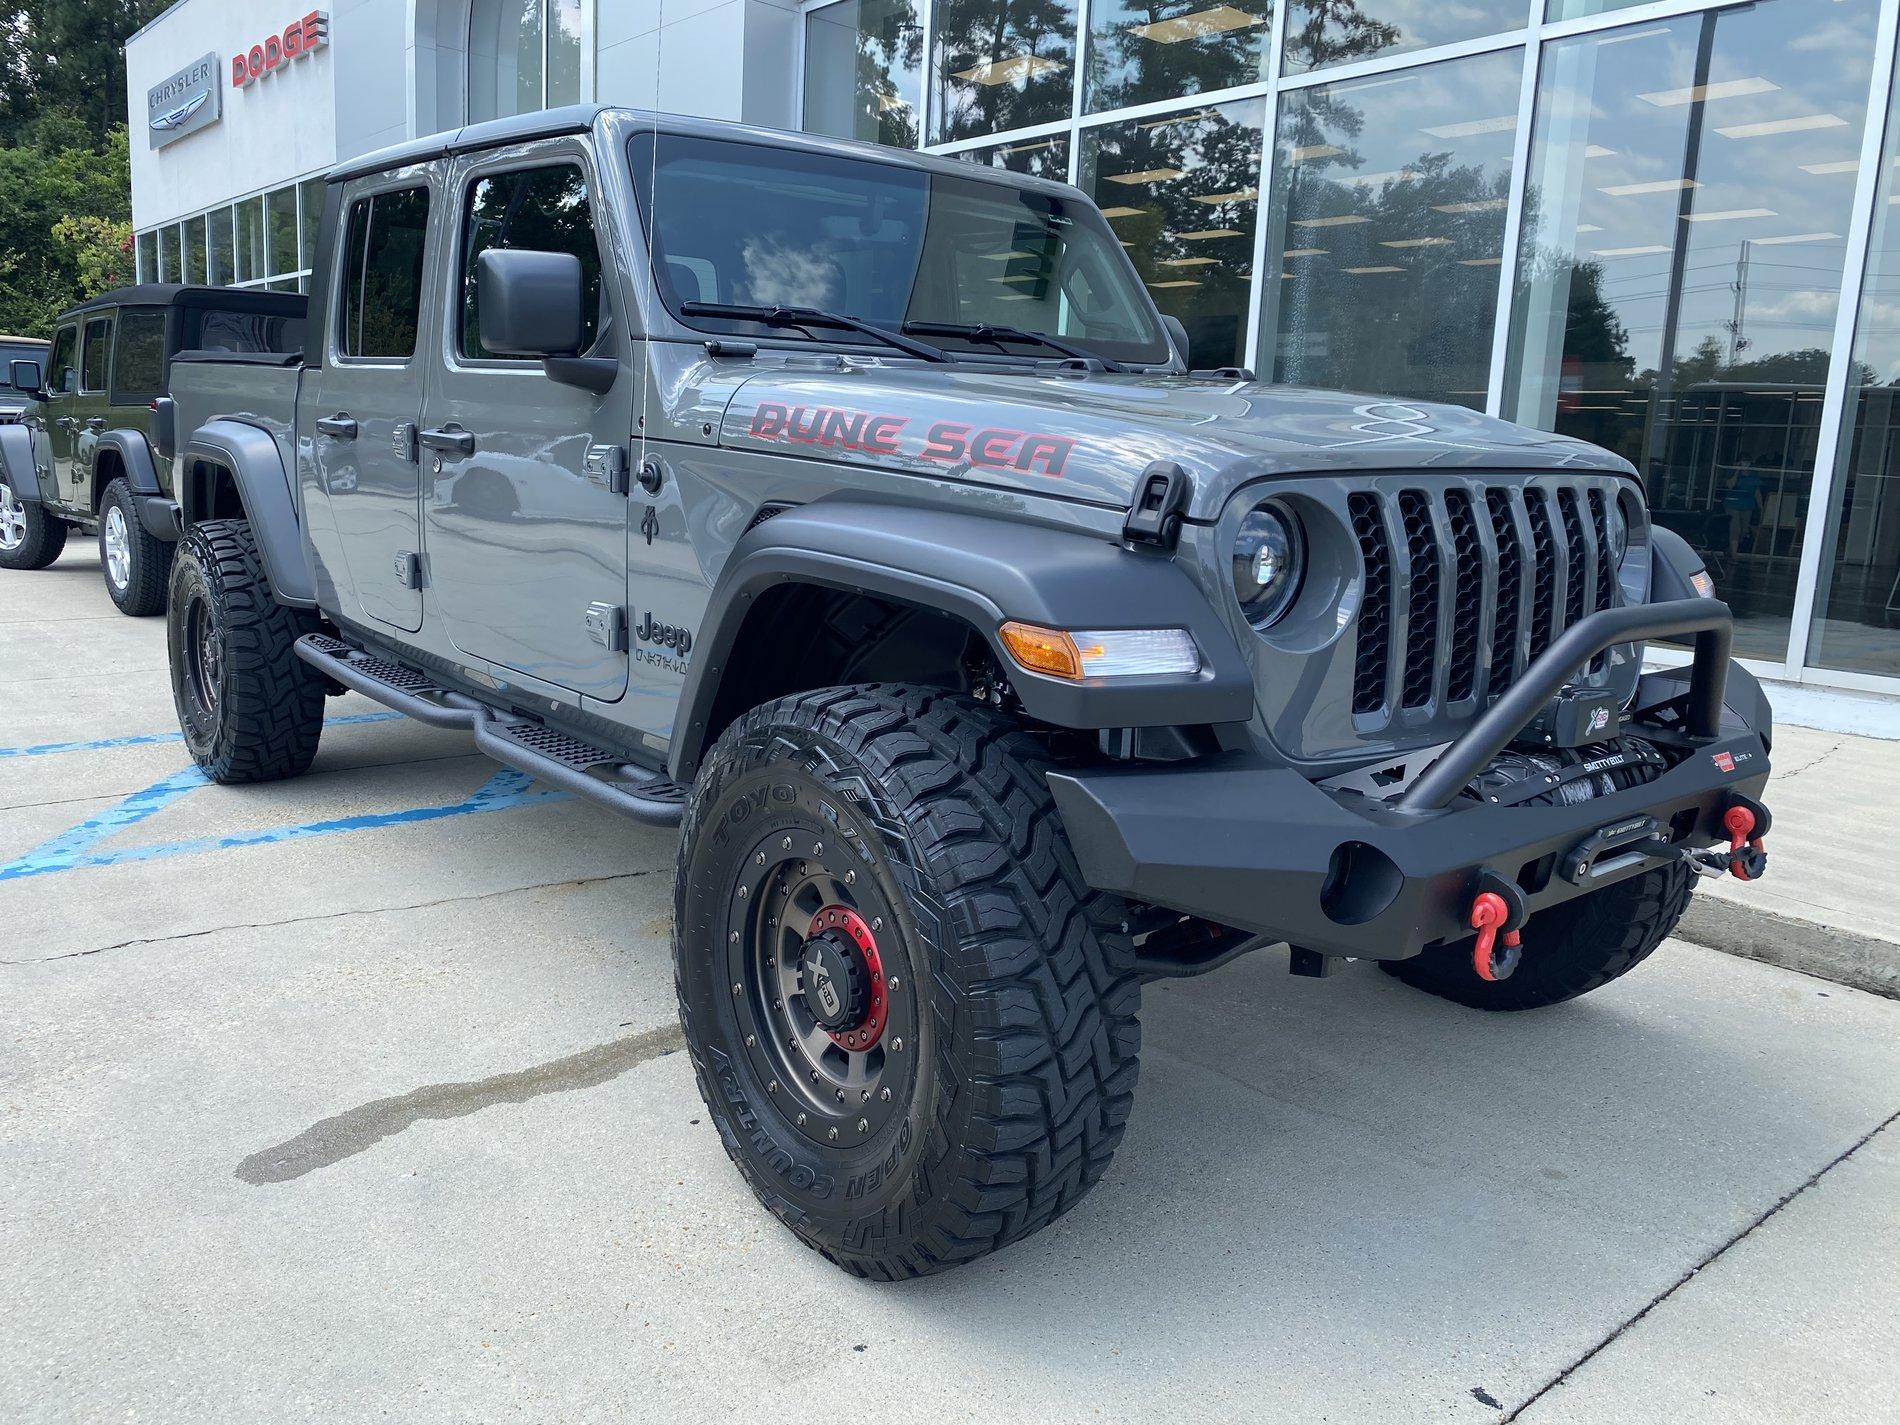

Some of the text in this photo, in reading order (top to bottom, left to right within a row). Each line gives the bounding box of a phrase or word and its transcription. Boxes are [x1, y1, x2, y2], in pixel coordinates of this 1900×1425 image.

[232, 10, 328, 88] DODGE
[149, 63, 209, 108] CHRYSLER
[749, 400, 1079, 478] DUNE SEA
[636, 611, 692, 657] Jeep
[1583, 754, 1624, 772] SMITTYBILT
[711, 782, 797, 849] TOYO
[846, 1114, 912, 1200] OPEN
